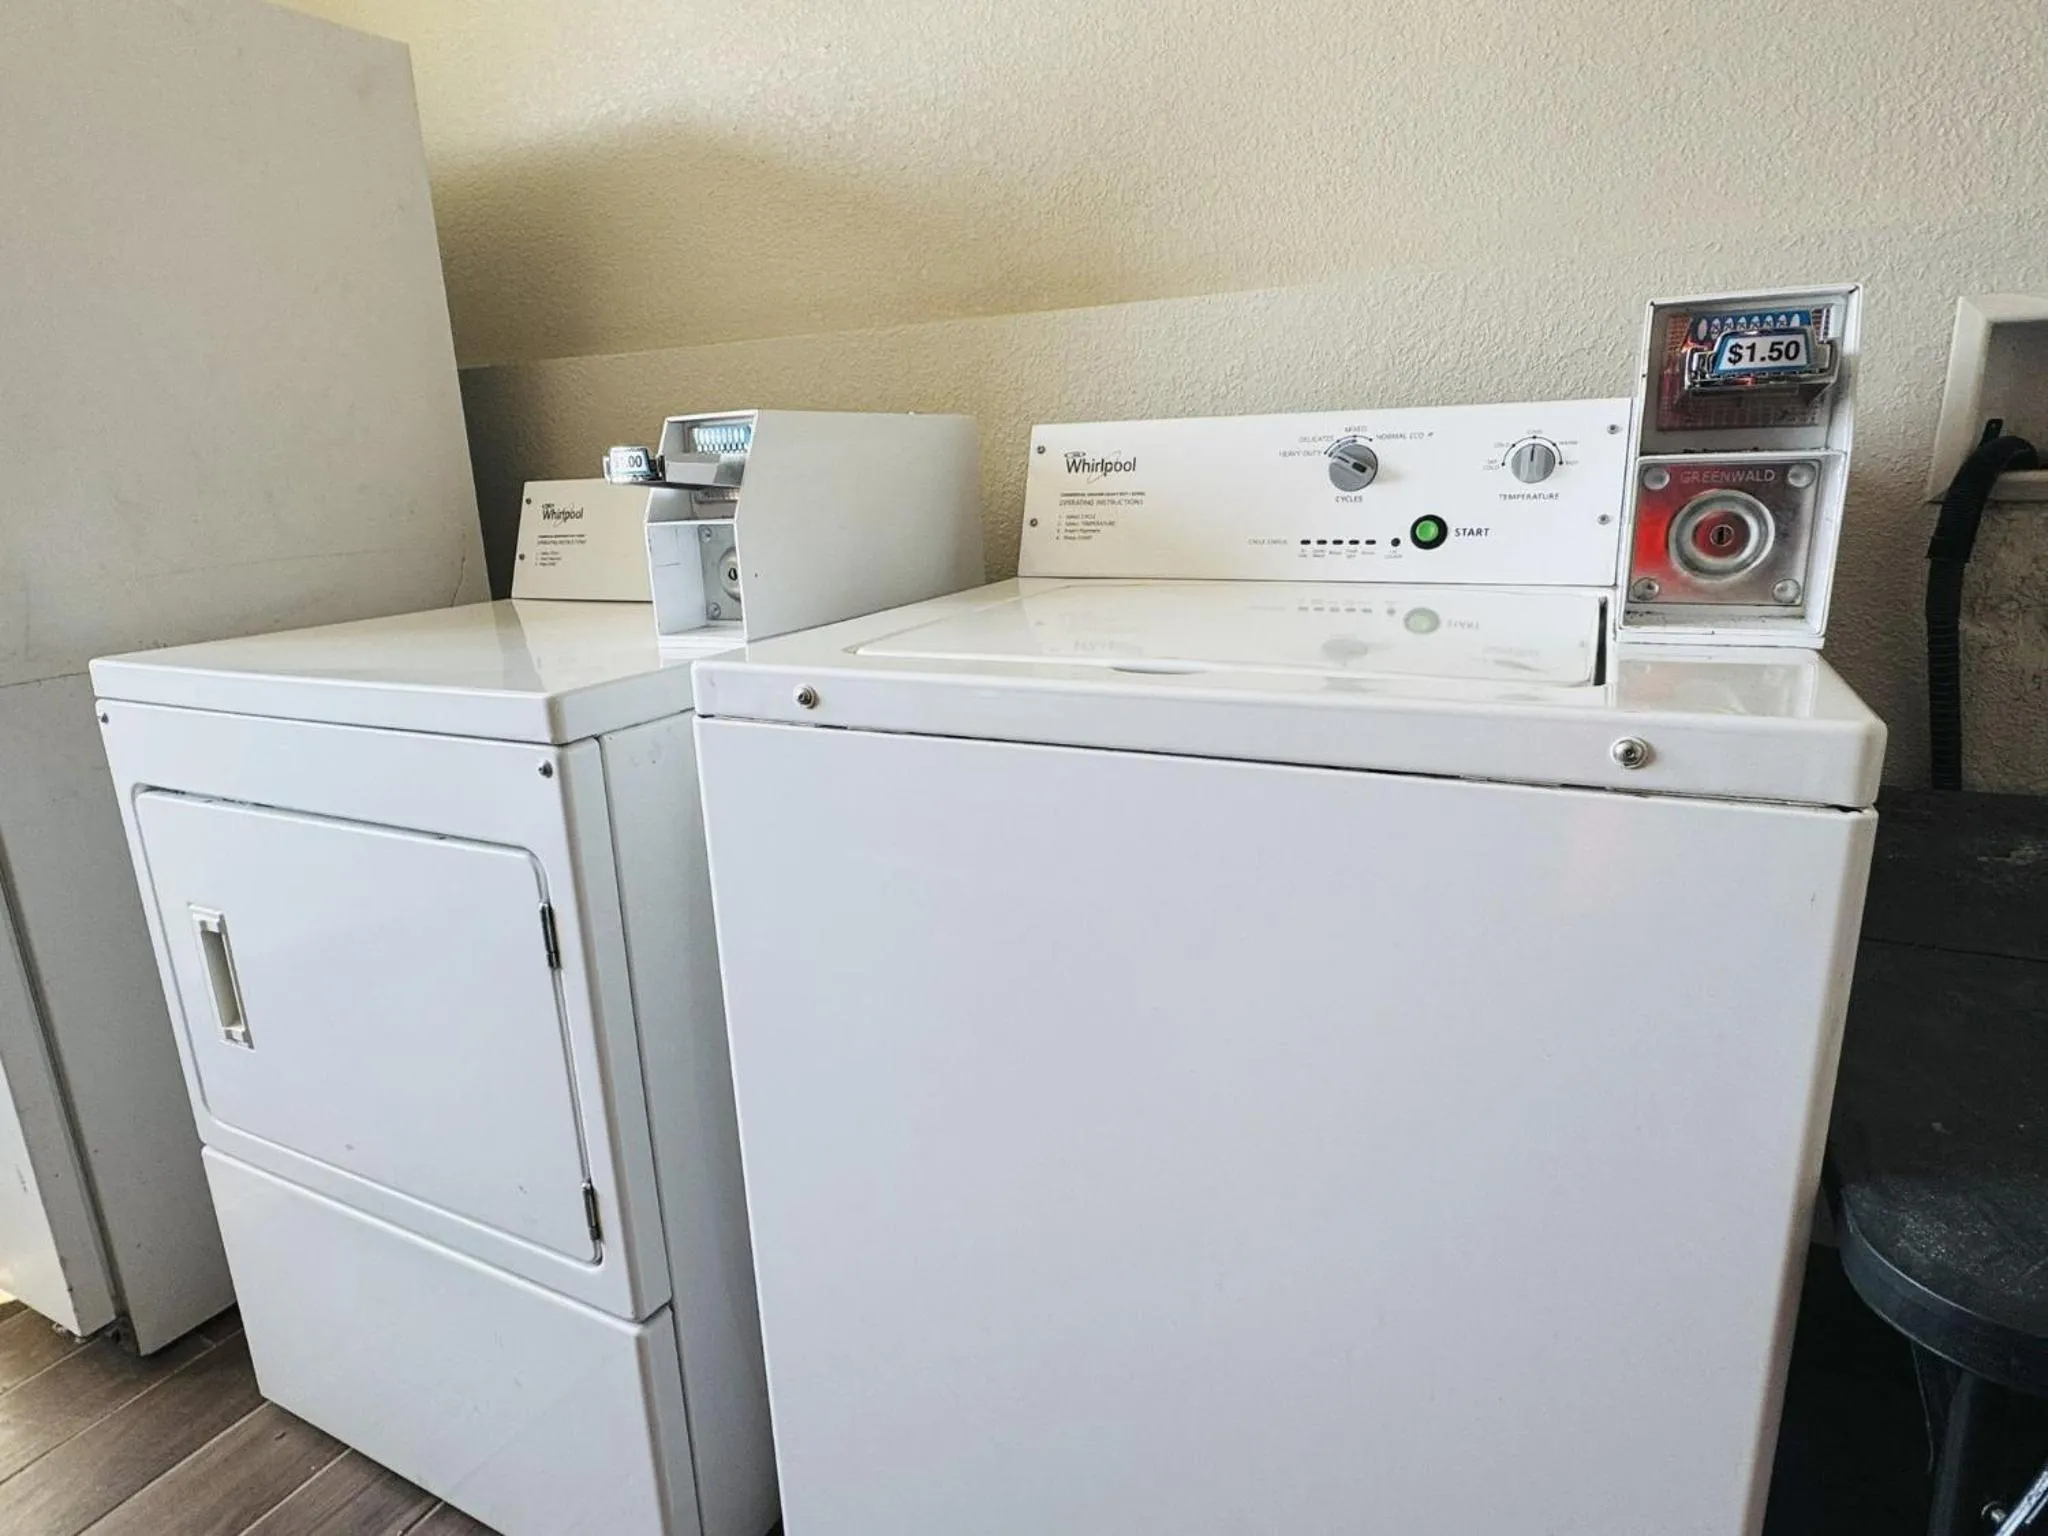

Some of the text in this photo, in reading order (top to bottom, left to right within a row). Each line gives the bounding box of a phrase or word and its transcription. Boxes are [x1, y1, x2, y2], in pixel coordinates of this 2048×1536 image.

[1728, 340, 1800, 365] $1.50
[1065, 456, 1137, 477] Whirlpool
[1680, 469, 1776, 484] GREENWALD
[1335, 495, 1363, 503] CYCLES
[1499, 492, 1560, 501] TEMPERATURE
[1454, 527, 1490, 537] START
